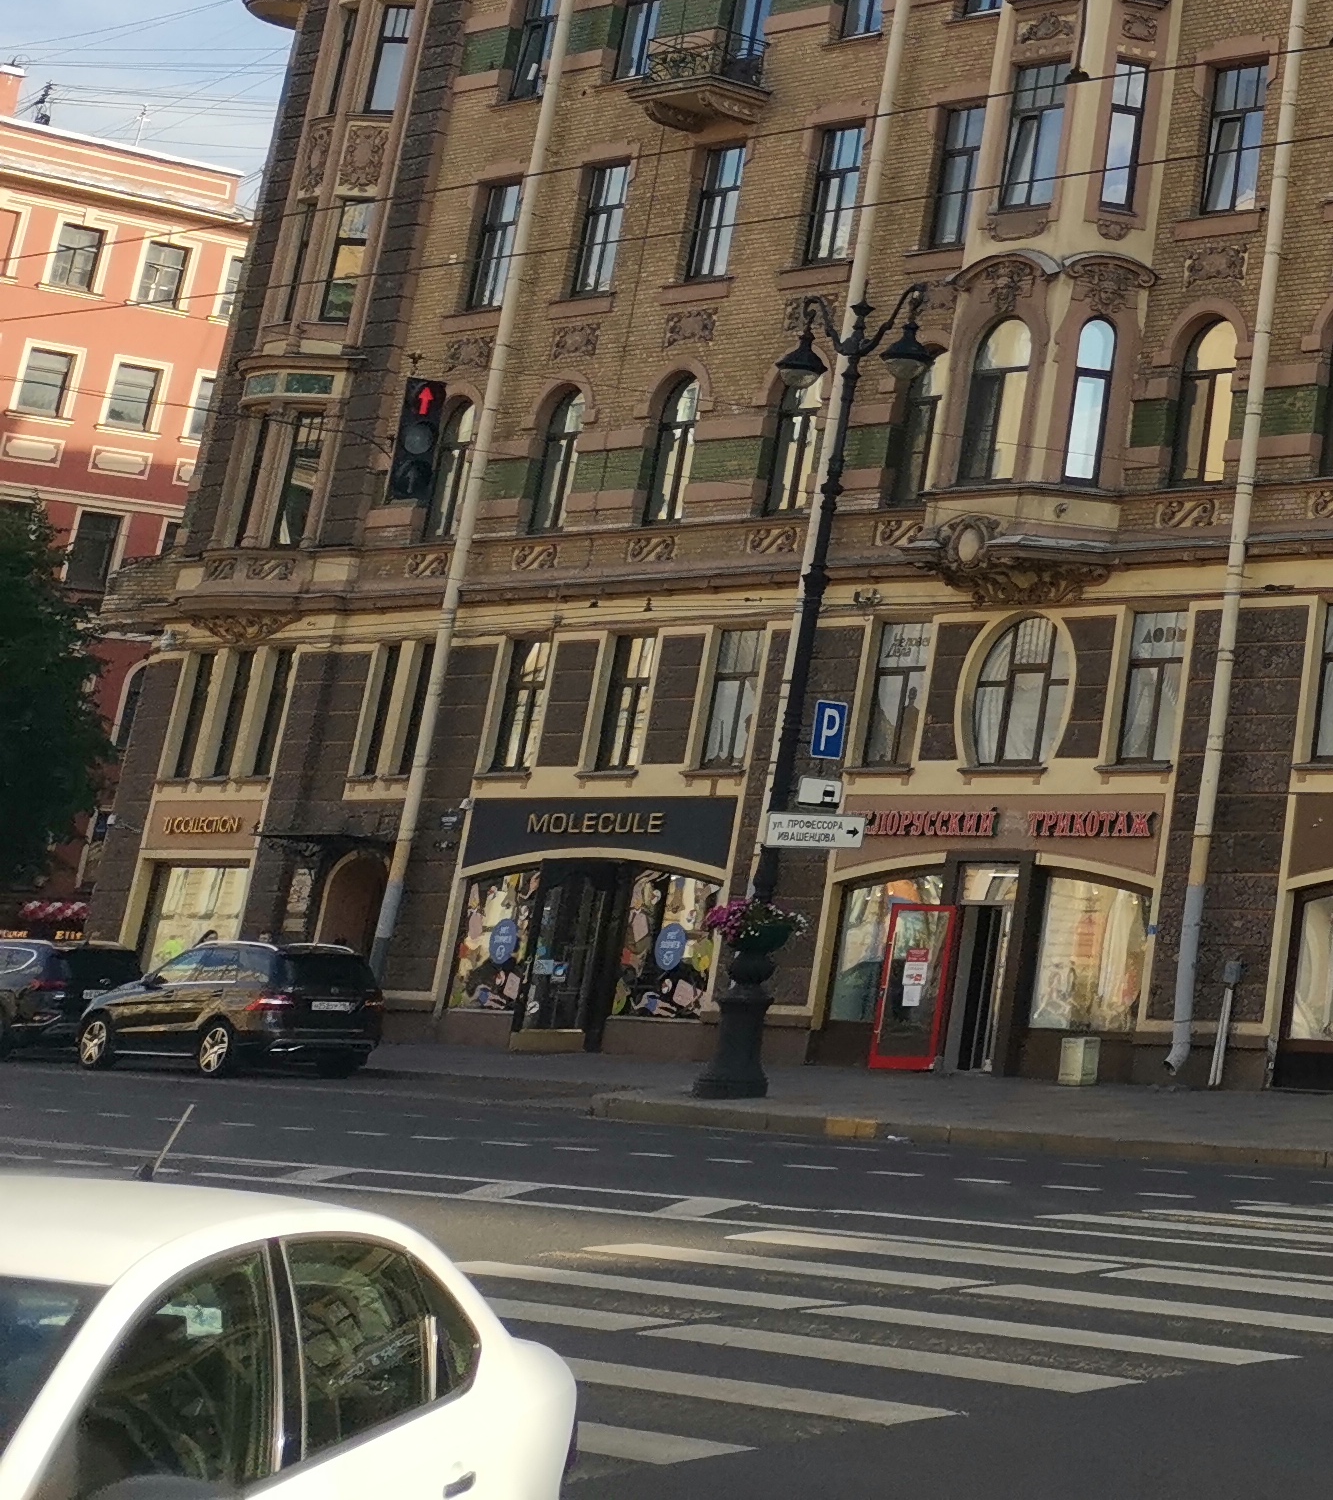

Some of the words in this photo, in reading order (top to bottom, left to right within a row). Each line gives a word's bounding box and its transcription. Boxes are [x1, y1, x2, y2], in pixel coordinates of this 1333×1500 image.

[819, 707, 840, 751] P
[173, 815, 240, 834] COLLECTION
[526, 812, 665, 834] MOLECULE
[787, 819, 844, 830] ПРОФЕССОРА
[850, 807, 997, 838] ЕЛОРУССКИЙ
[1028, 811, 1151, 838] ТРИКОТАЖ
[777, 831, 836, 843] ИВАШЕНЦОВА
